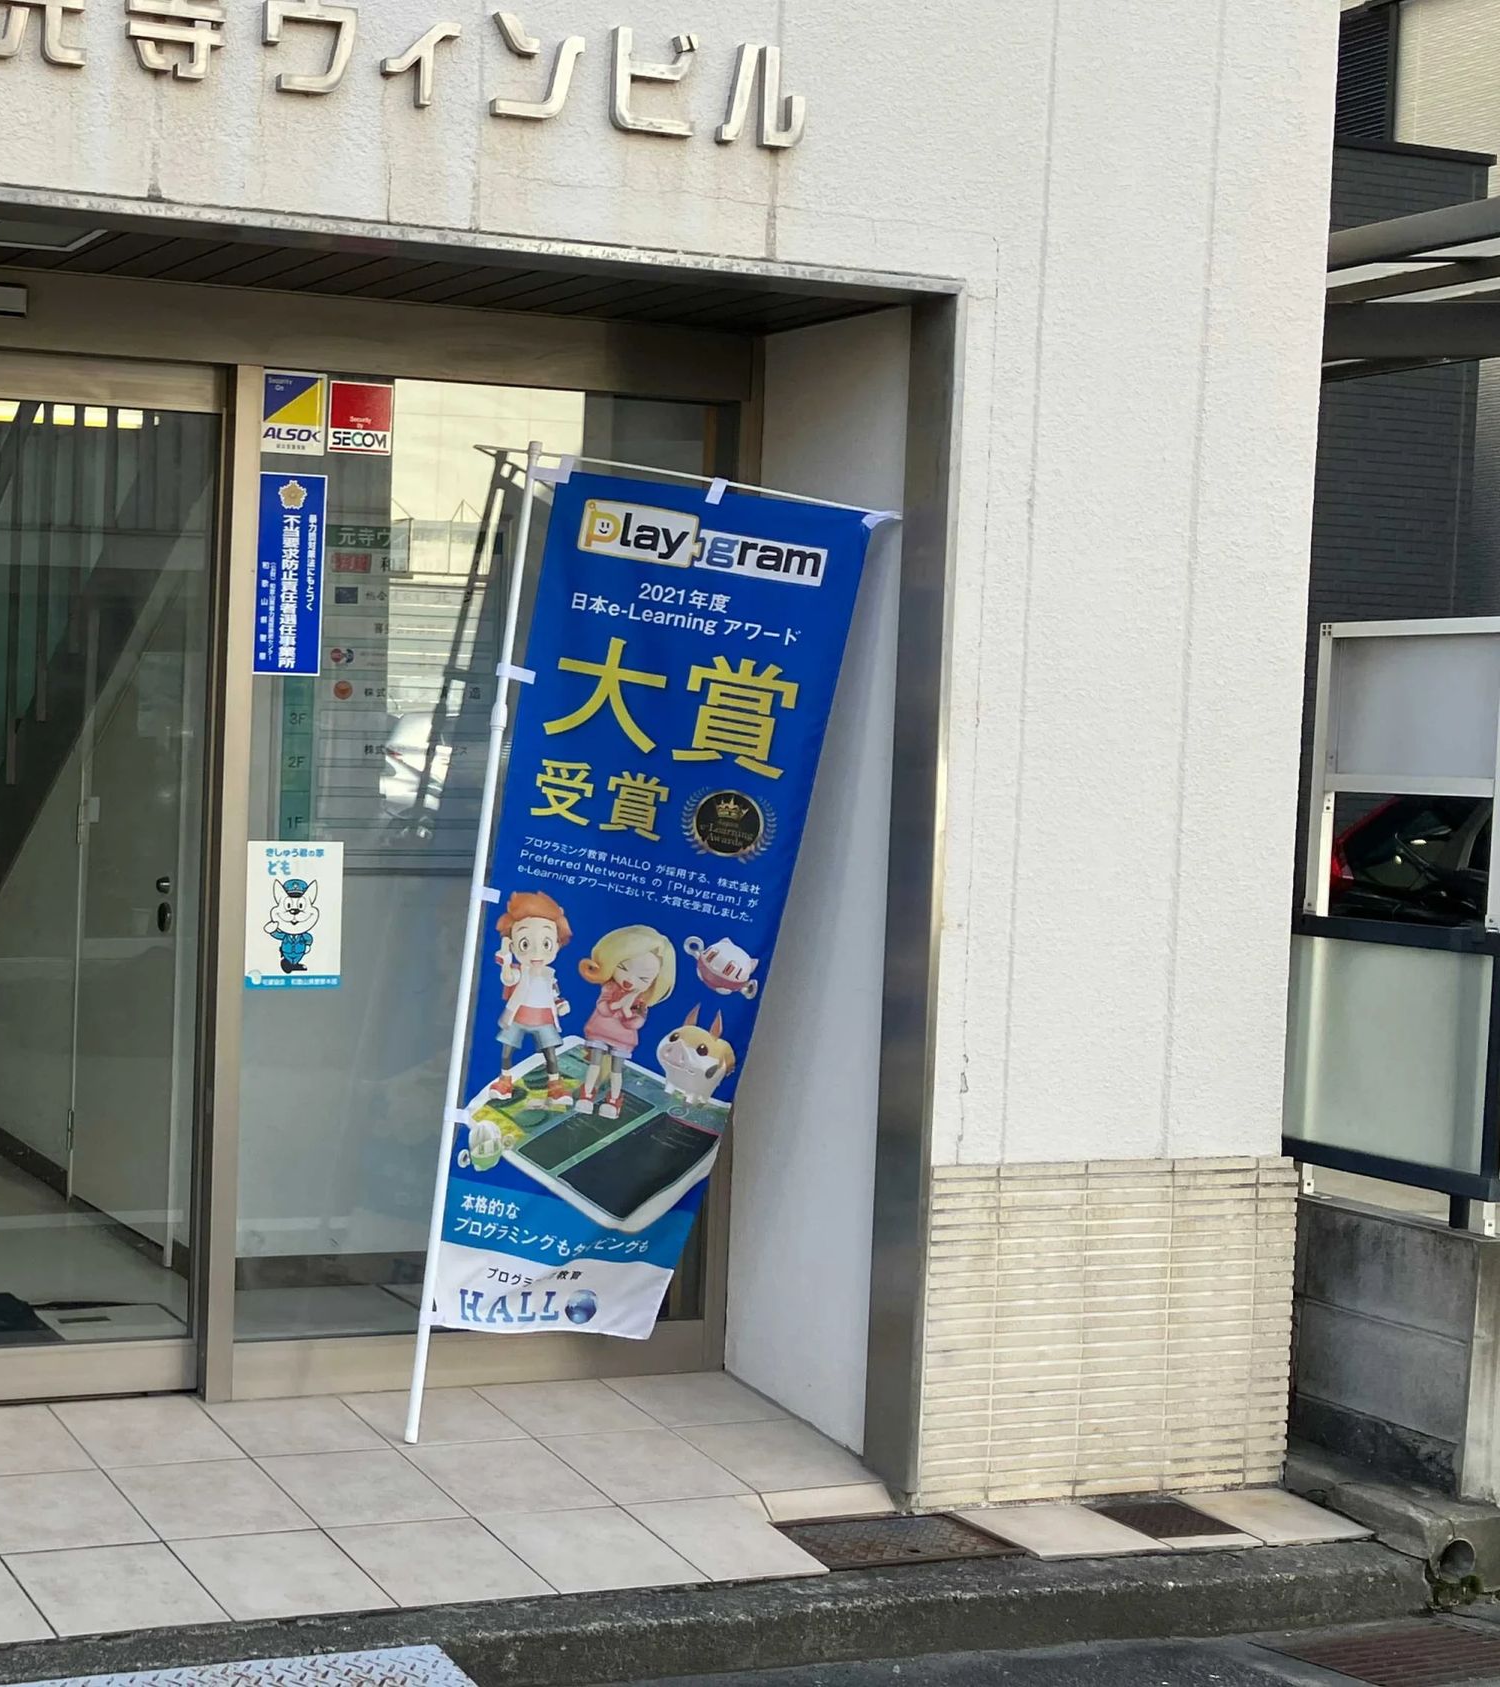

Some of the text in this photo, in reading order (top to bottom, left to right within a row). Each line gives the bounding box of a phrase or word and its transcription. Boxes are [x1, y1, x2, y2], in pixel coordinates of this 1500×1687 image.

[263, 427, 321, 443] ALSOK
[332, 431, 387, 449] SECOM
[277, 514, 301, 669] 不当要求防止責任者選任事業所
[638, 582, 731, 614] 2021年度
[571, 592, 802, 646] 日本e-Learning アワード
[289, 712, 307, 726] 3F
[543, 637, 799, 780] 大賞
[288, 756, 306, 769] 2F
[530, 759, 670, 842] 受賞
[287, 816, 304, 830] 1F
[517, 864, 576, 885] e-Learning
[520, 849, 581, 870] Preferred
[584, 862, 646, 885] Networks
[524, 836, 608, 863] プログラミング教育
[610, 854, 651, 871] HALLO
[717, 877, 761, 895] 株式会社
[460, 1193, 521, 1220] 本格的な
